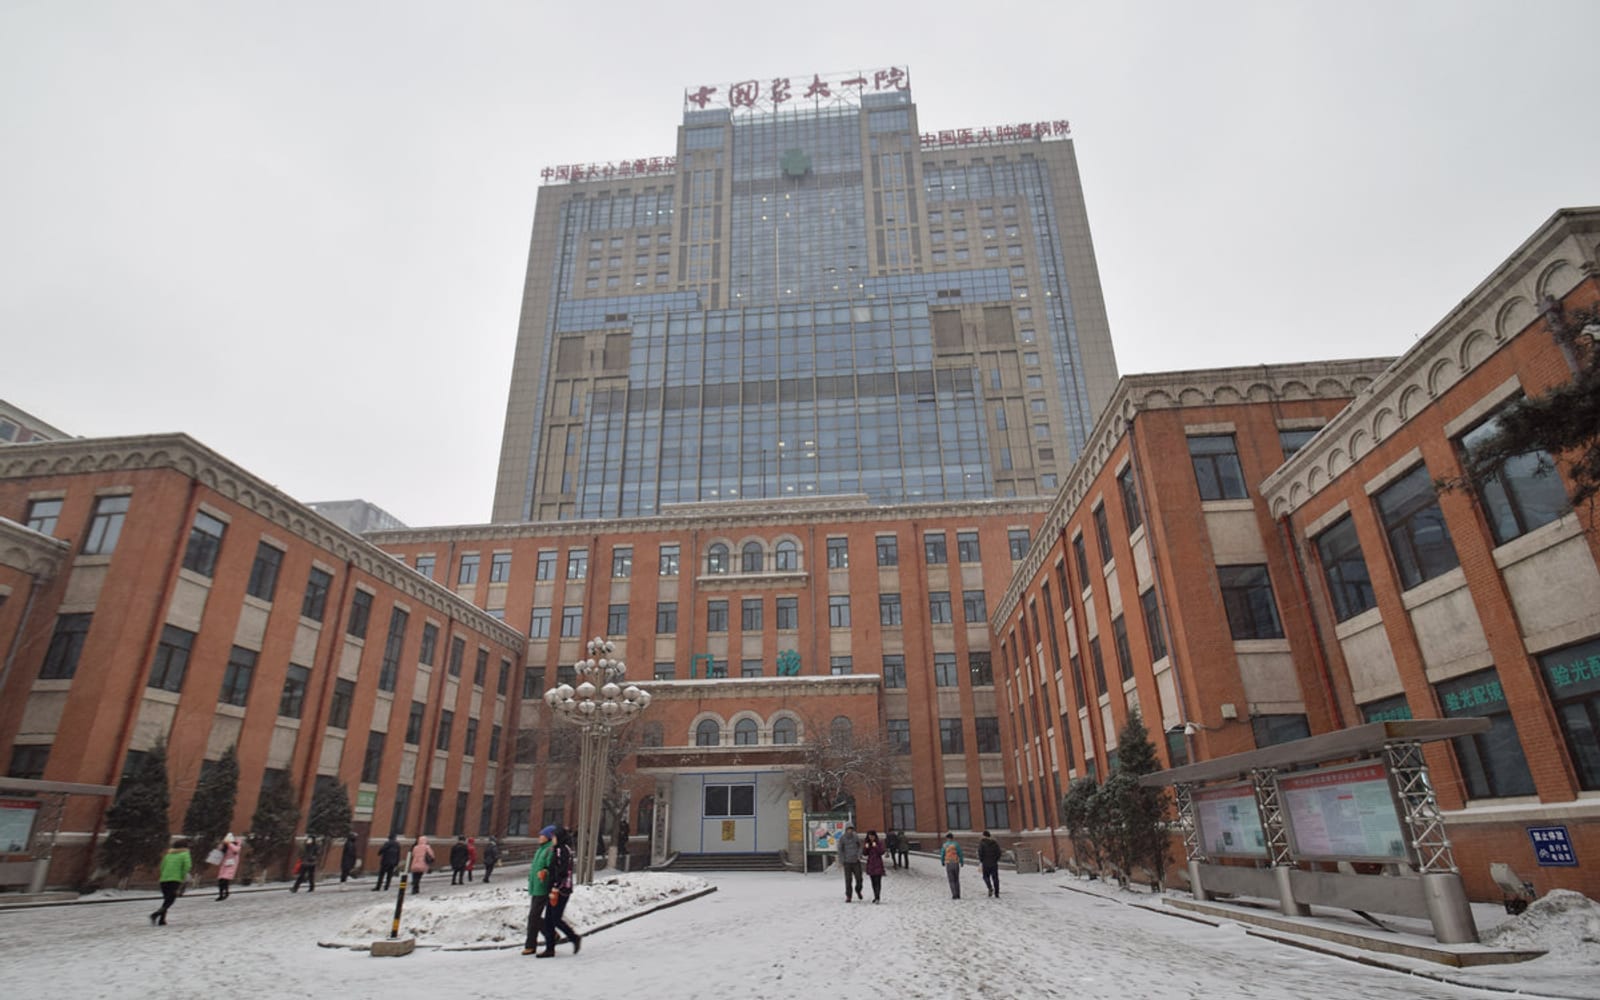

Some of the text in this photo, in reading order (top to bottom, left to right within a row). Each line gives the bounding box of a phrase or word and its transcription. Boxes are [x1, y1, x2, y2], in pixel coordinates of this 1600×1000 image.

[692, 650, 801, 678] 门诊
[1446, 682, 1503, 711] 验光配镜
